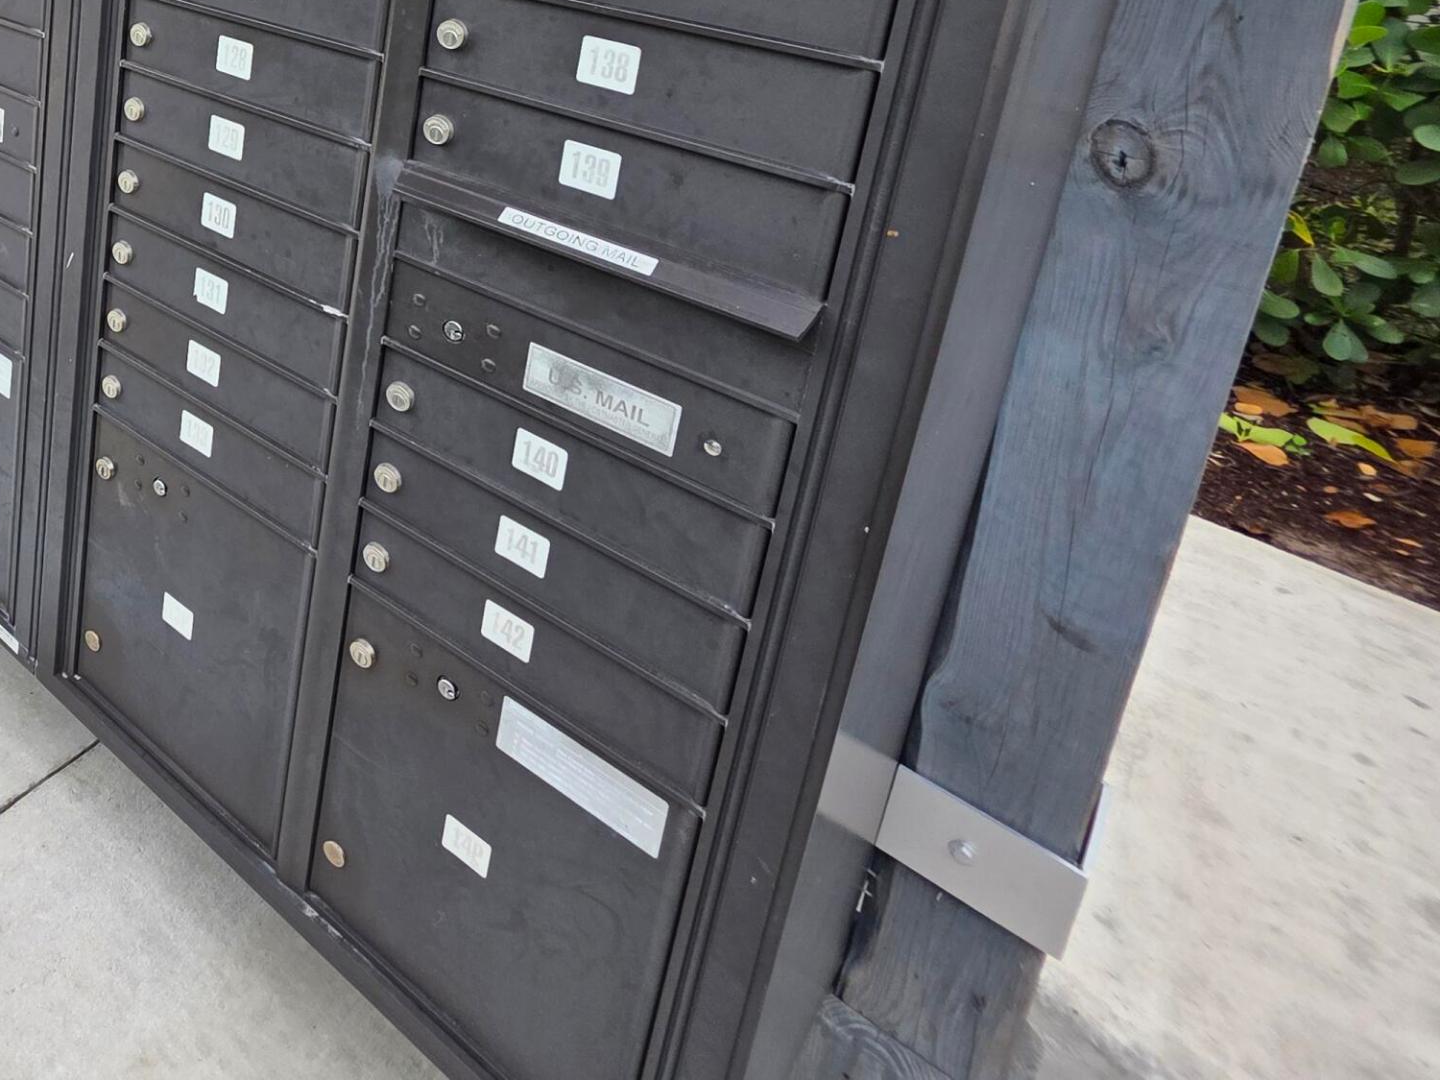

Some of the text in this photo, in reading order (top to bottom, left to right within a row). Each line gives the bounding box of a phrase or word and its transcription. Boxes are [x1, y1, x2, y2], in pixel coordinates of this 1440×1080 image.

[589, 46, 630, 83] 138
[572, 151, 611, 188] 139
[207, 201, 230, 230] 130
[511, 213, 641, 268] OUTGOING MAIL
[200, 276, 222, 305] 131
[594, 389, 649, 427] MAIL
[522, 439, 559, 478] 140
[506, 528, 538, 565] 141
[491, 612, 525, 650] 142
